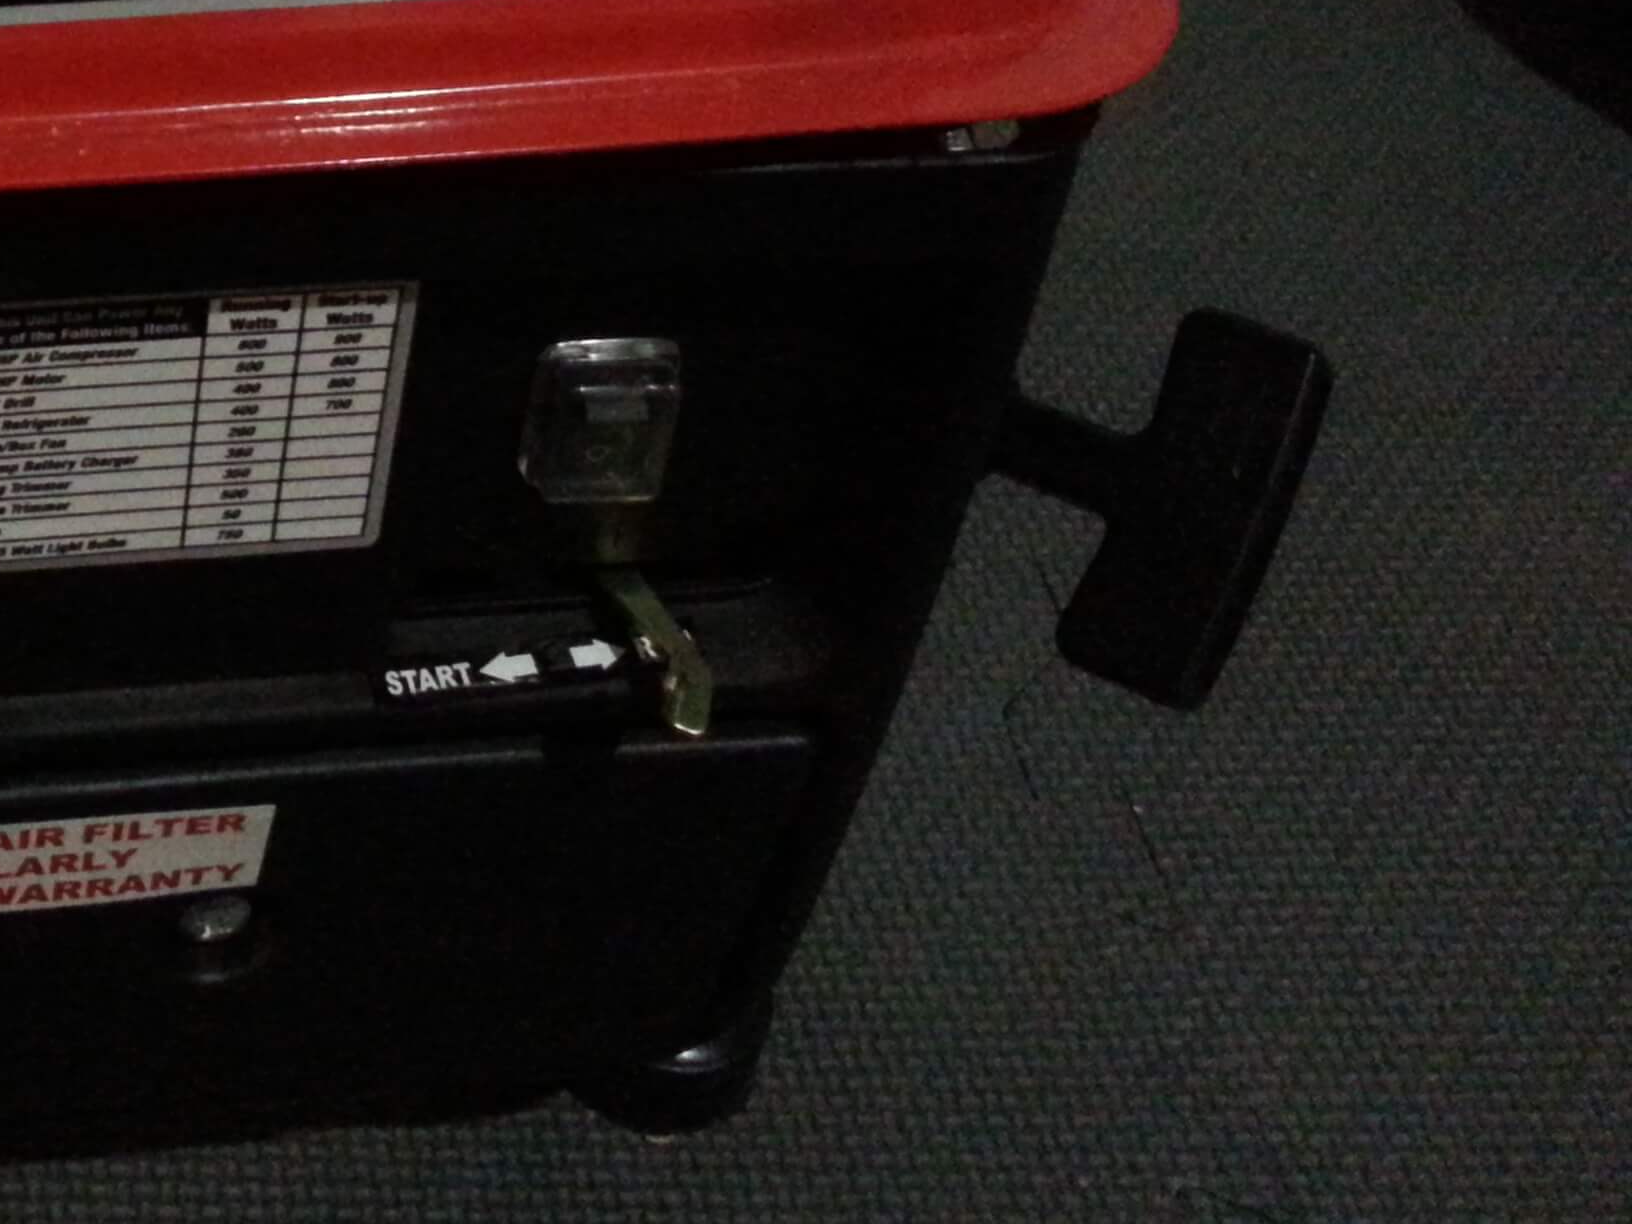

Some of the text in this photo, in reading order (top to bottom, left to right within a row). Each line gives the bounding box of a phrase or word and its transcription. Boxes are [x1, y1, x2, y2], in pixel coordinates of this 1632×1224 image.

[230, 312, 374, 330] Watts Watts
[383, 661, 472, 697] START
[83, 813, 247, 844] FILTER
